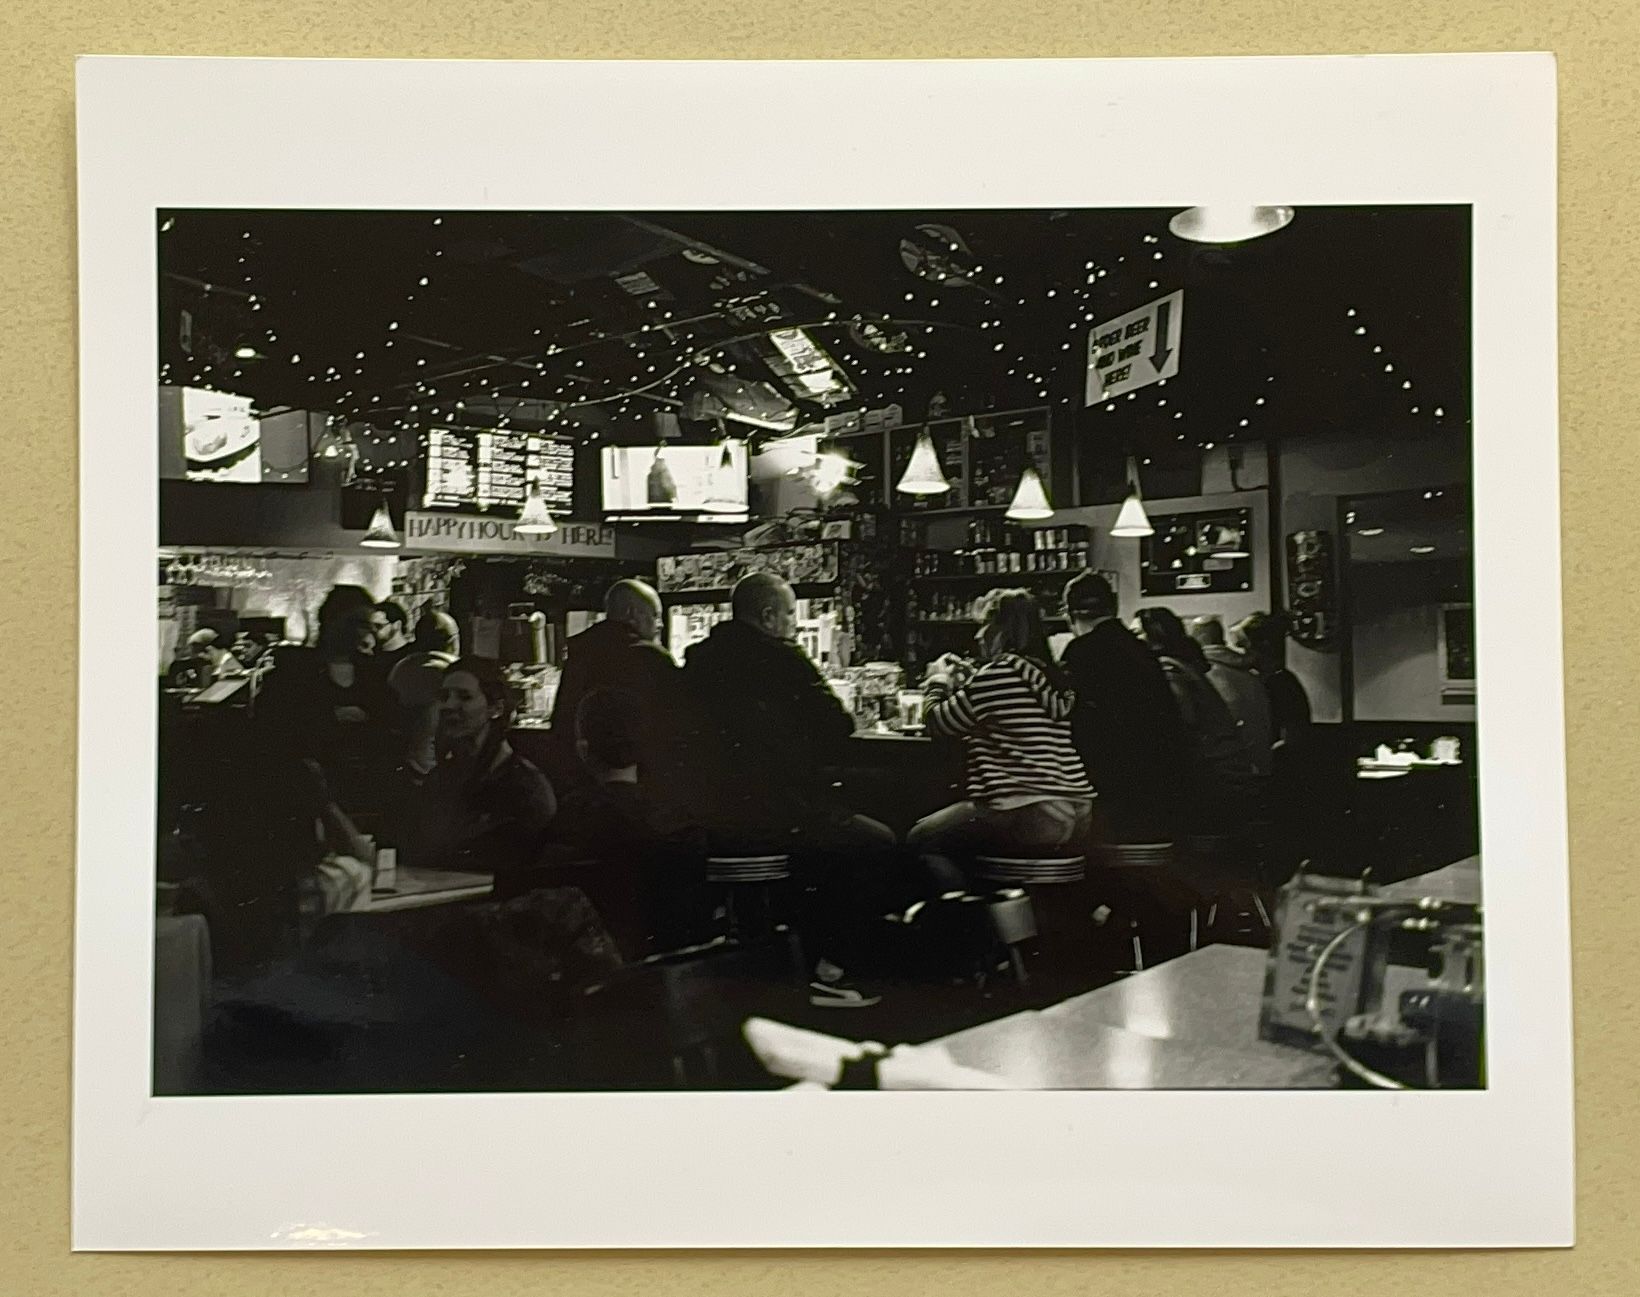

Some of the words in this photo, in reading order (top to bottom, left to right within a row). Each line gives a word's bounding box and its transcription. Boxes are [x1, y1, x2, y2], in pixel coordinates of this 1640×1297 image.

[1124, 316, 1151, 340] BEER
[1095, 351, 1115, 369] AND
[1118, 339, 1143, 362] WINE
[408, 517, 467, 540] HAPPY
